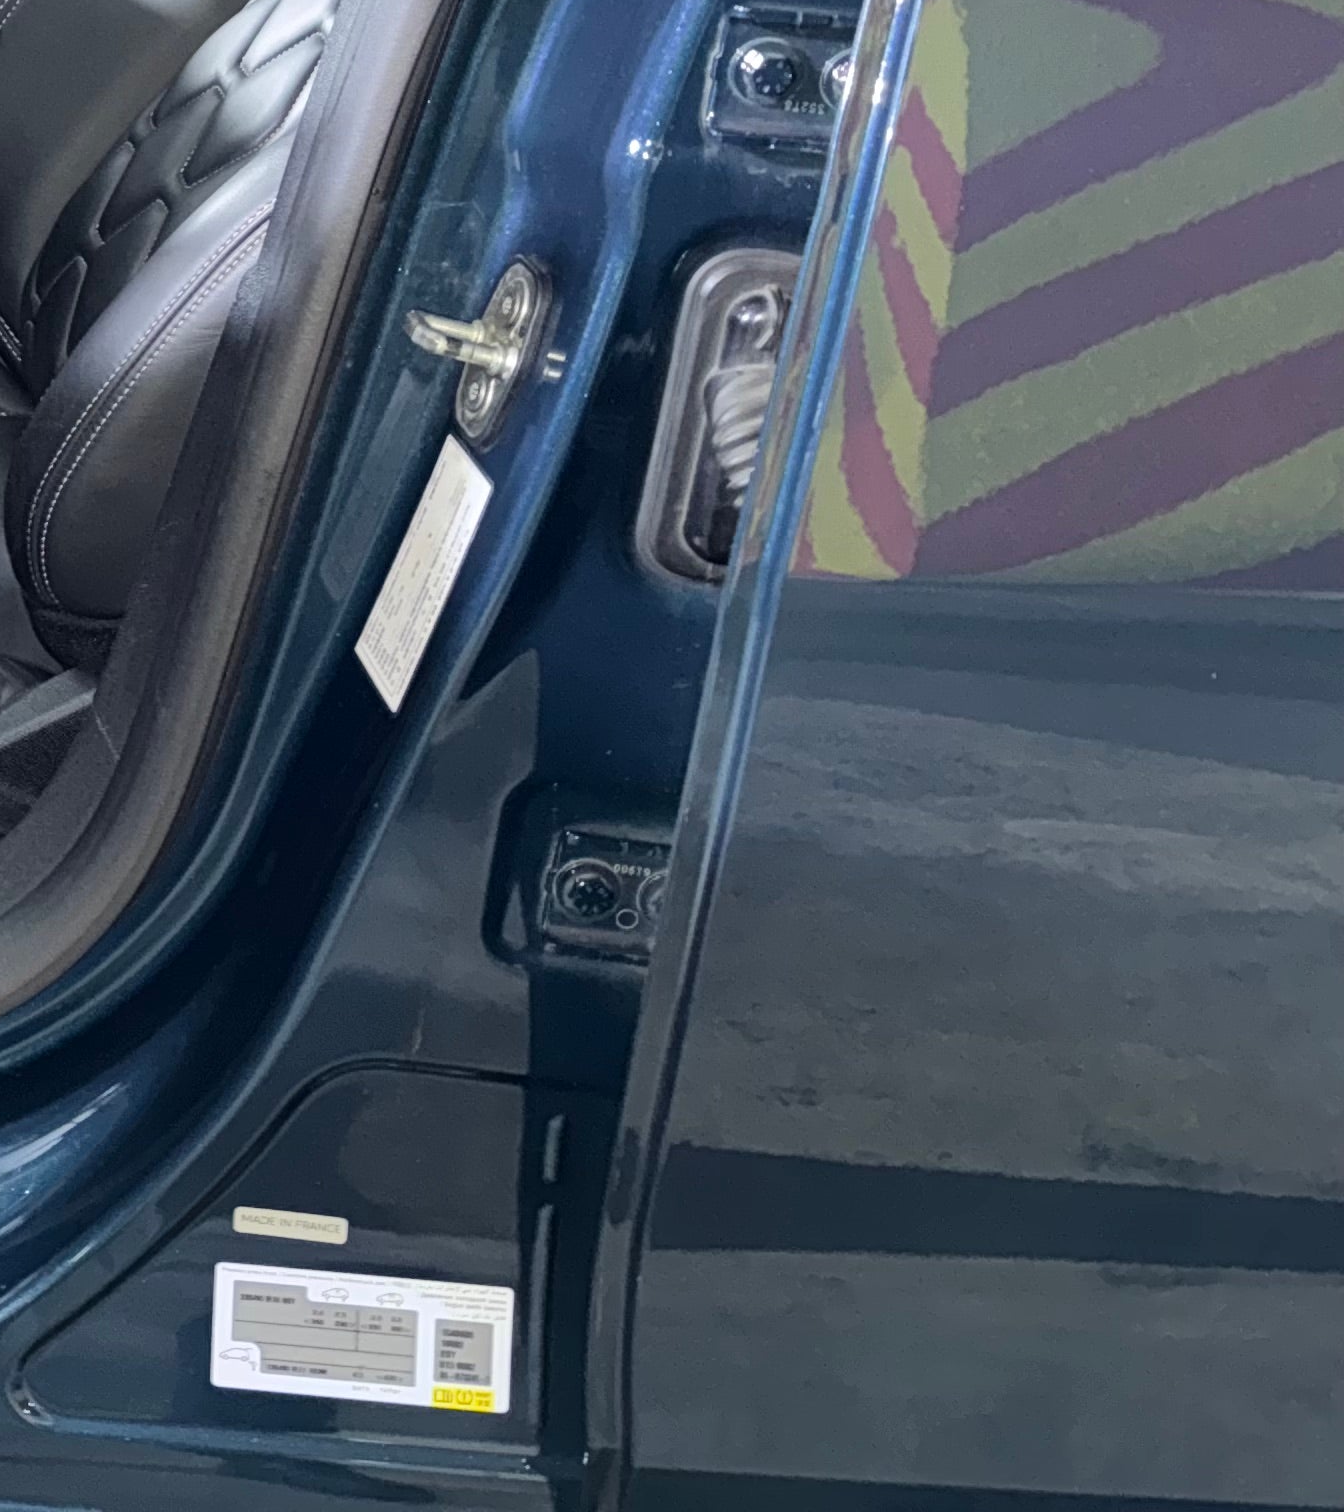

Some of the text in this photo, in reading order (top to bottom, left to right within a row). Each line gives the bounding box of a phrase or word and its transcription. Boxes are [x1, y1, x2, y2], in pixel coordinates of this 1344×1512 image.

[240, 1213, 342, 1234] MADE IN FRANCE
